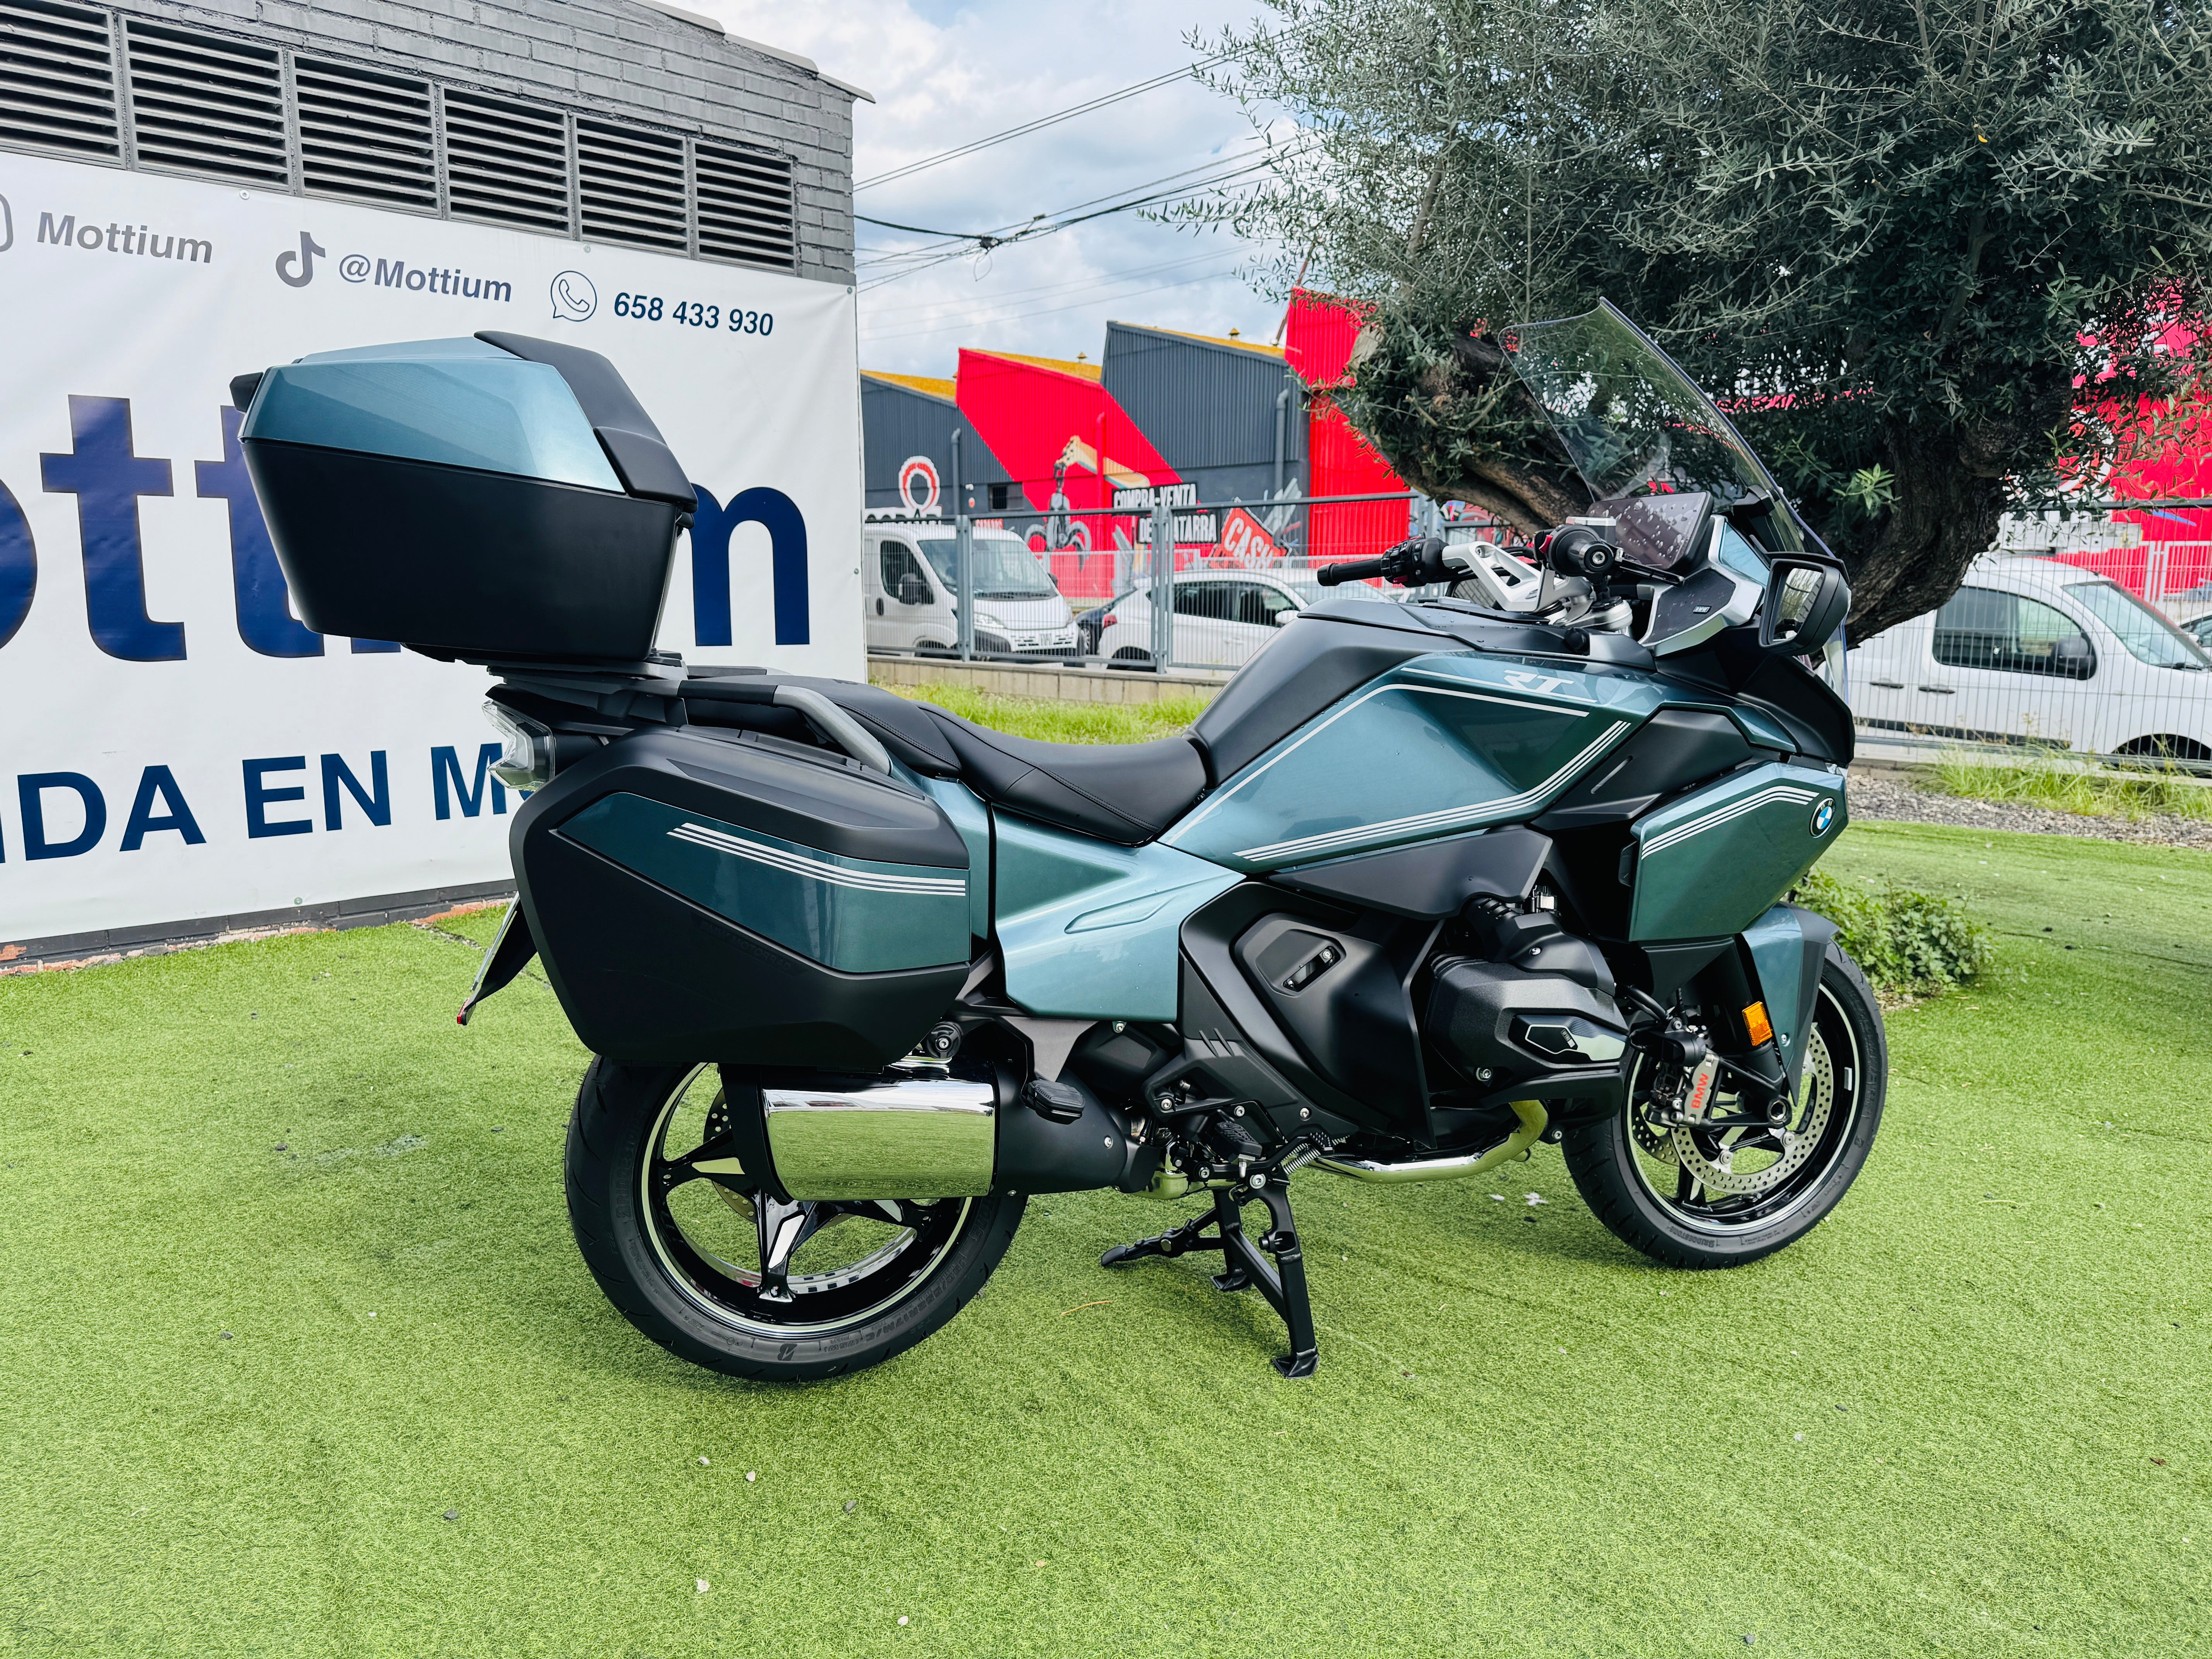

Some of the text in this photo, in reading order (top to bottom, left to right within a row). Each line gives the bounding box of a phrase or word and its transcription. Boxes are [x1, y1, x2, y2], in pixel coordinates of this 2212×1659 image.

[37, 211, 213, 263] Mottium
[339, 254, 512, 302] @Mottium
[614, 292, 774, 336] 658 433 930
[1114, 484, 1197, 509] COMPRA-VENTA
[1504, 670, 1575, 692] RT
[0, 742, 527, 864] DA EN M
[730, 935, 792, 970] MOTORRAD
[1691, 1072, 1709, 1109] BMW
